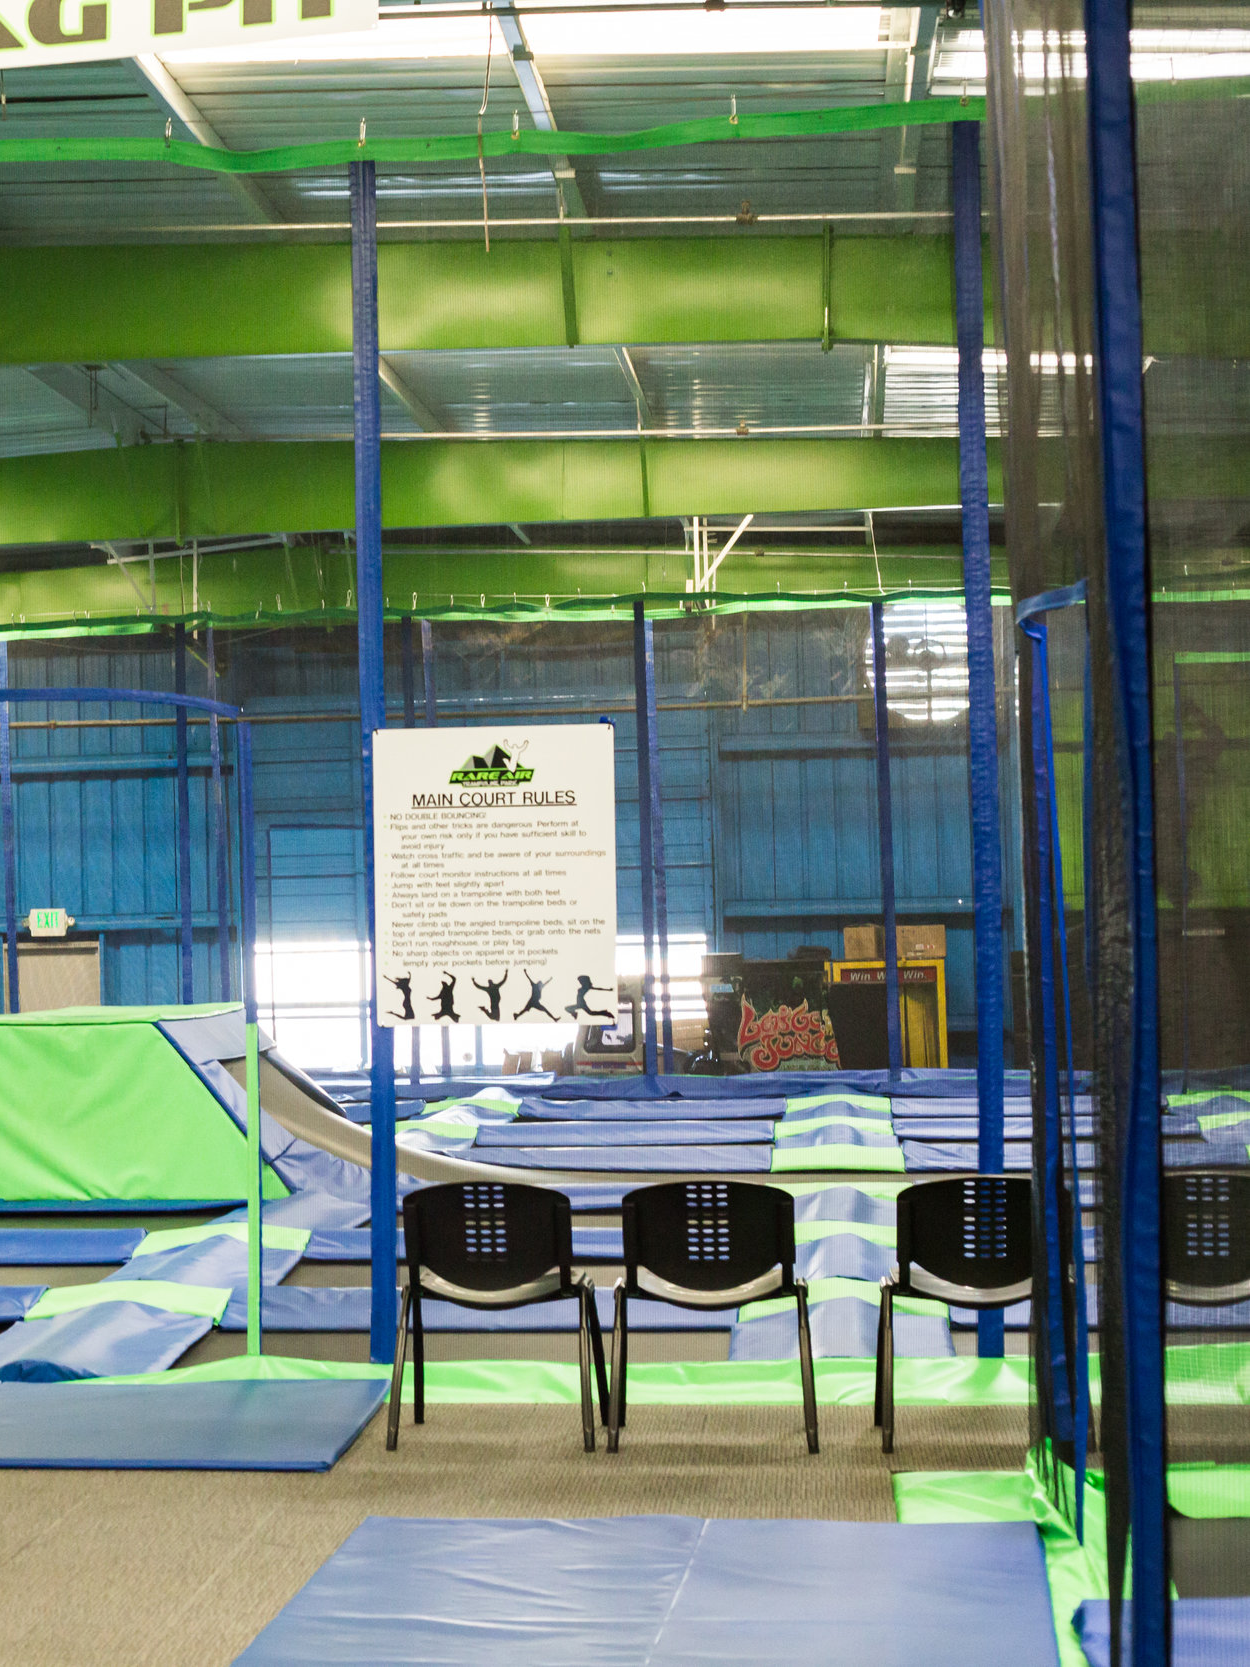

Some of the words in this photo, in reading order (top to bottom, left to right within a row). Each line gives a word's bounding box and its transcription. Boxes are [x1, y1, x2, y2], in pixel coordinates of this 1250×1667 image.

[452, 772, 500, 781] RARE
[501, 770, 532, 780] AIR
[412, 793, 453, 807] MAIN
[459, 792, 516, 807] COURT
[523, 790, 576, 806] RULES
[390, 813, 402, 821] NO
[390, 823, 408, 831] Flips
[456, 832, 473, 840] only
[484, 832, 498, 840] you
[522, 830, 558, 838] sufficient
[555, 849, 607, 857] surroundings
[390, 871, 415, 879] Follow
[453, 880, 480, 888] slightly
[484, 880, 504, 888] apart
[461, 890, 502, 898] trampoline
[391, 901, 411, 909] Don't
[502, 899, 544, 908] trampoline
[402, 911, 425, 919] safety
[37, 912, 60, 928] EXIT
[469, 920, 496, 928] angled
[498, 919, 540, 927] trampoline
[392, 930, 405, 938] top
[419, 930, 445, 938] angled
[448, 929, 489, 937] trampoline
[527, 928, 545, 936] grab
[406, 950, 428, 958] sharp
[431, 949, 459, 957] objects
[475, 949, 505, 957] apparel
[527, 948, 558, 956] pockets
[452, 959, 482, 967] pockets
[513, 958, 548, 967] jumping)
